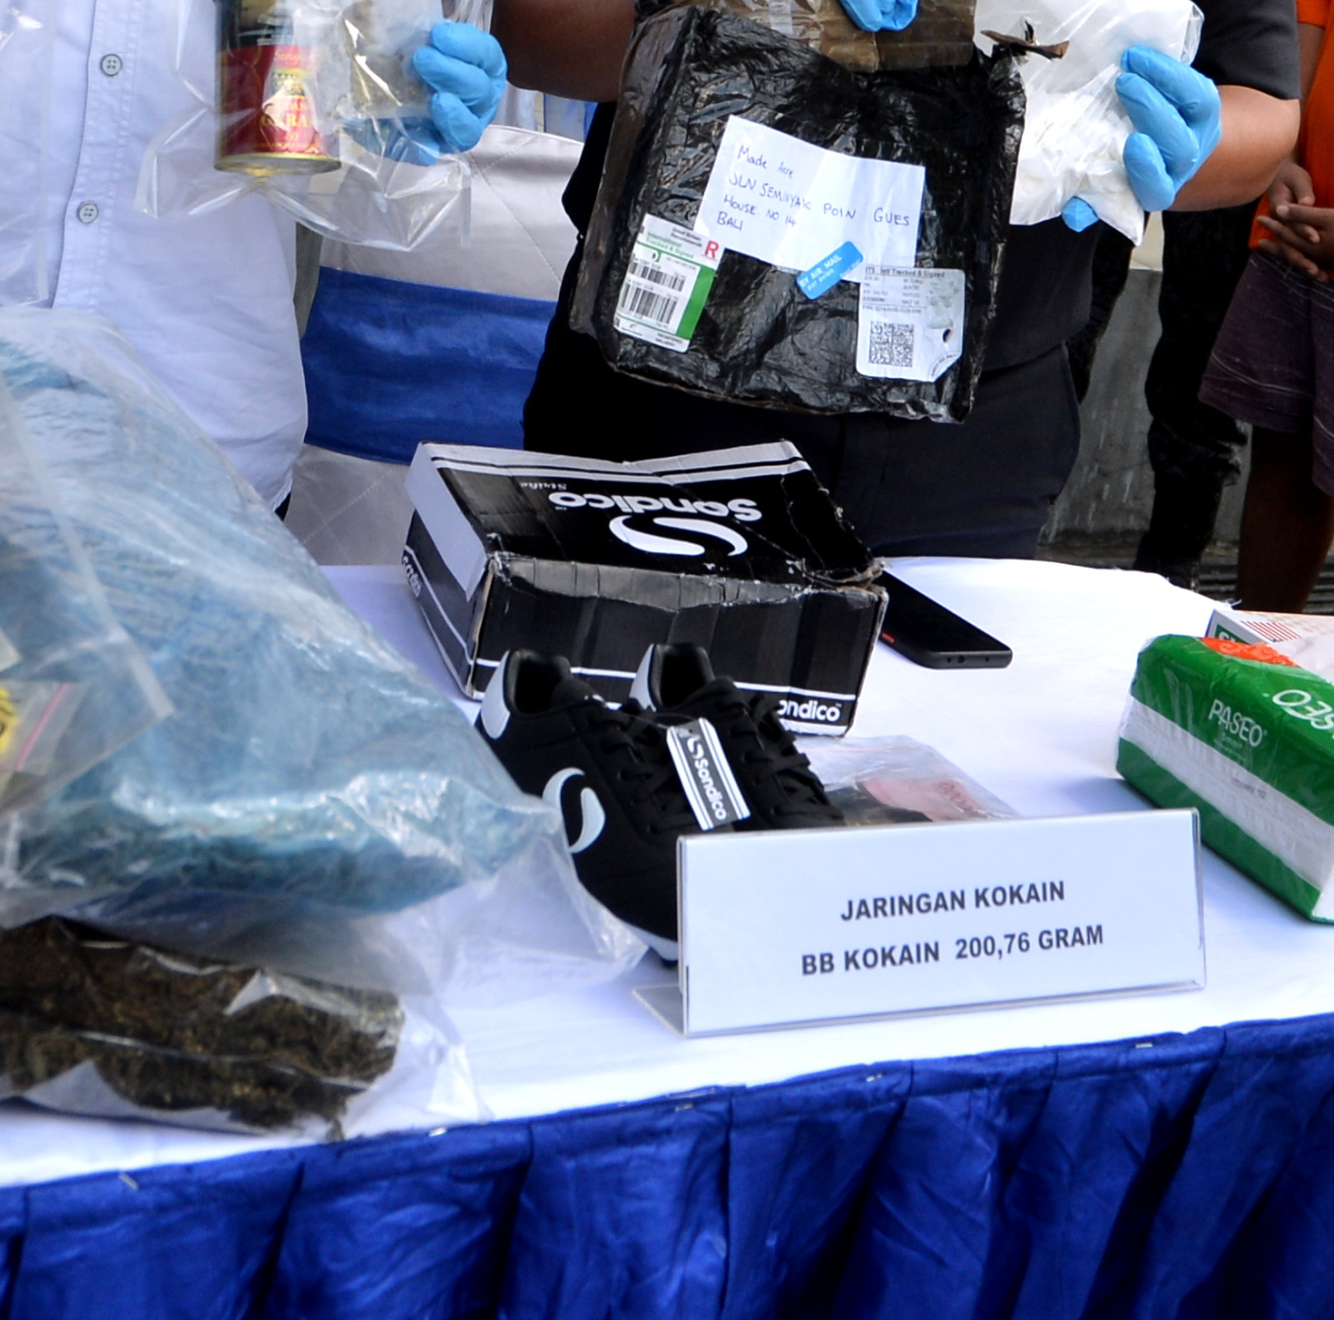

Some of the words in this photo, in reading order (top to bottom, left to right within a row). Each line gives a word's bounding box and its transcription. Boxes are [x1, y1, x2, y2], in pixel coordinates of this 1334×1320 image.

[716, 210, 745, 232] BALI
[873, 207, 910, 227] GUES
[704, 240, 720, 260] R
[810, 266, 824, 282] AIR
[823, 253, 843, 274] MAIL
[548, 491, 763, 523] Sondico
[1208, 698, 1264, 748] PASEO
[693, 756, 727, 821] Sondico
[840, 889, 966, 921] JARINGAN
[974, 880, 1066, 909] KOKAIN
[801, 951, 836, 977] BB
[843, 941, 940, 972] KOKAIN
[954, 931, 1031, 961] 200,76
[1037, 924, 1105, 952] GRAM
